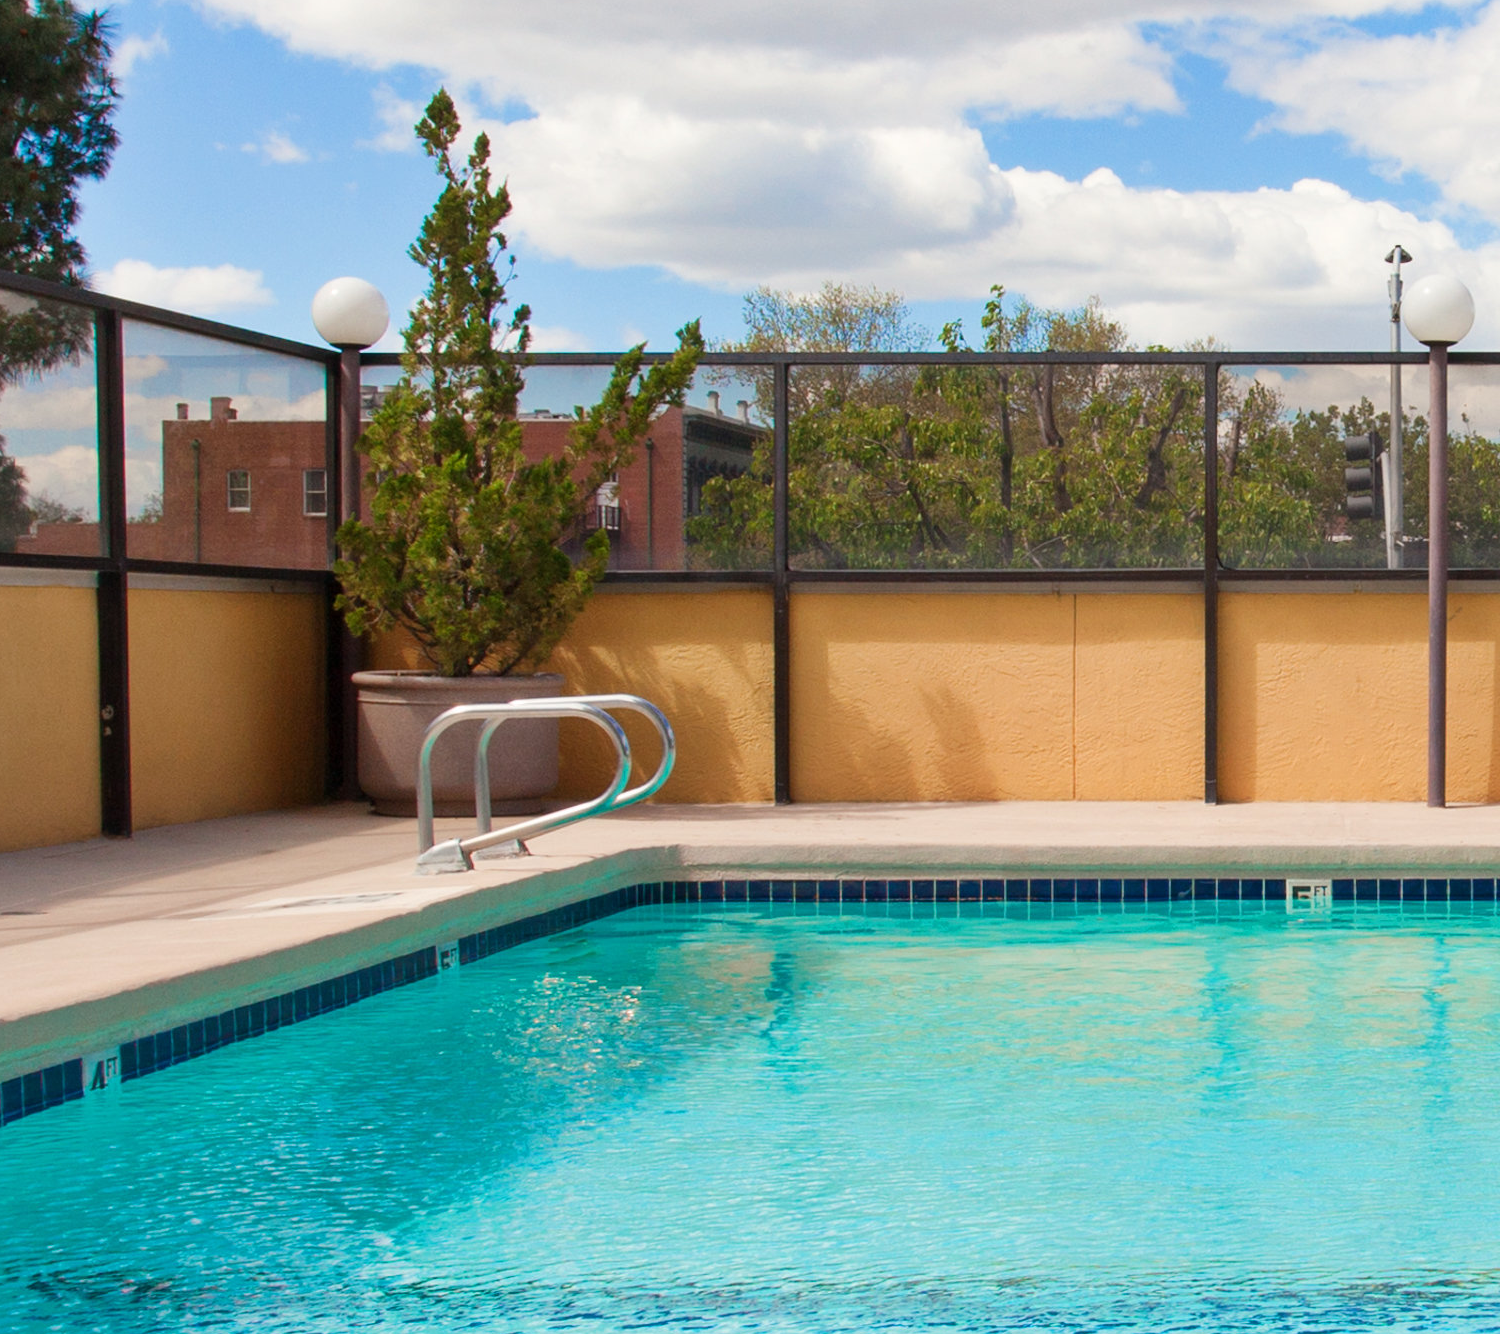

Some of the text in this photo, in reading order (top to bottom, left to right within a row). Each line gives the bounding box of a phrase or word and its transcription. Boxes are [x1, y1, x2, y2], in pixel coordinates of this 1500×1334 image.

[1313, 885, 1328, 897] FT
[90, 1056, 118, 1091] 4 FT
